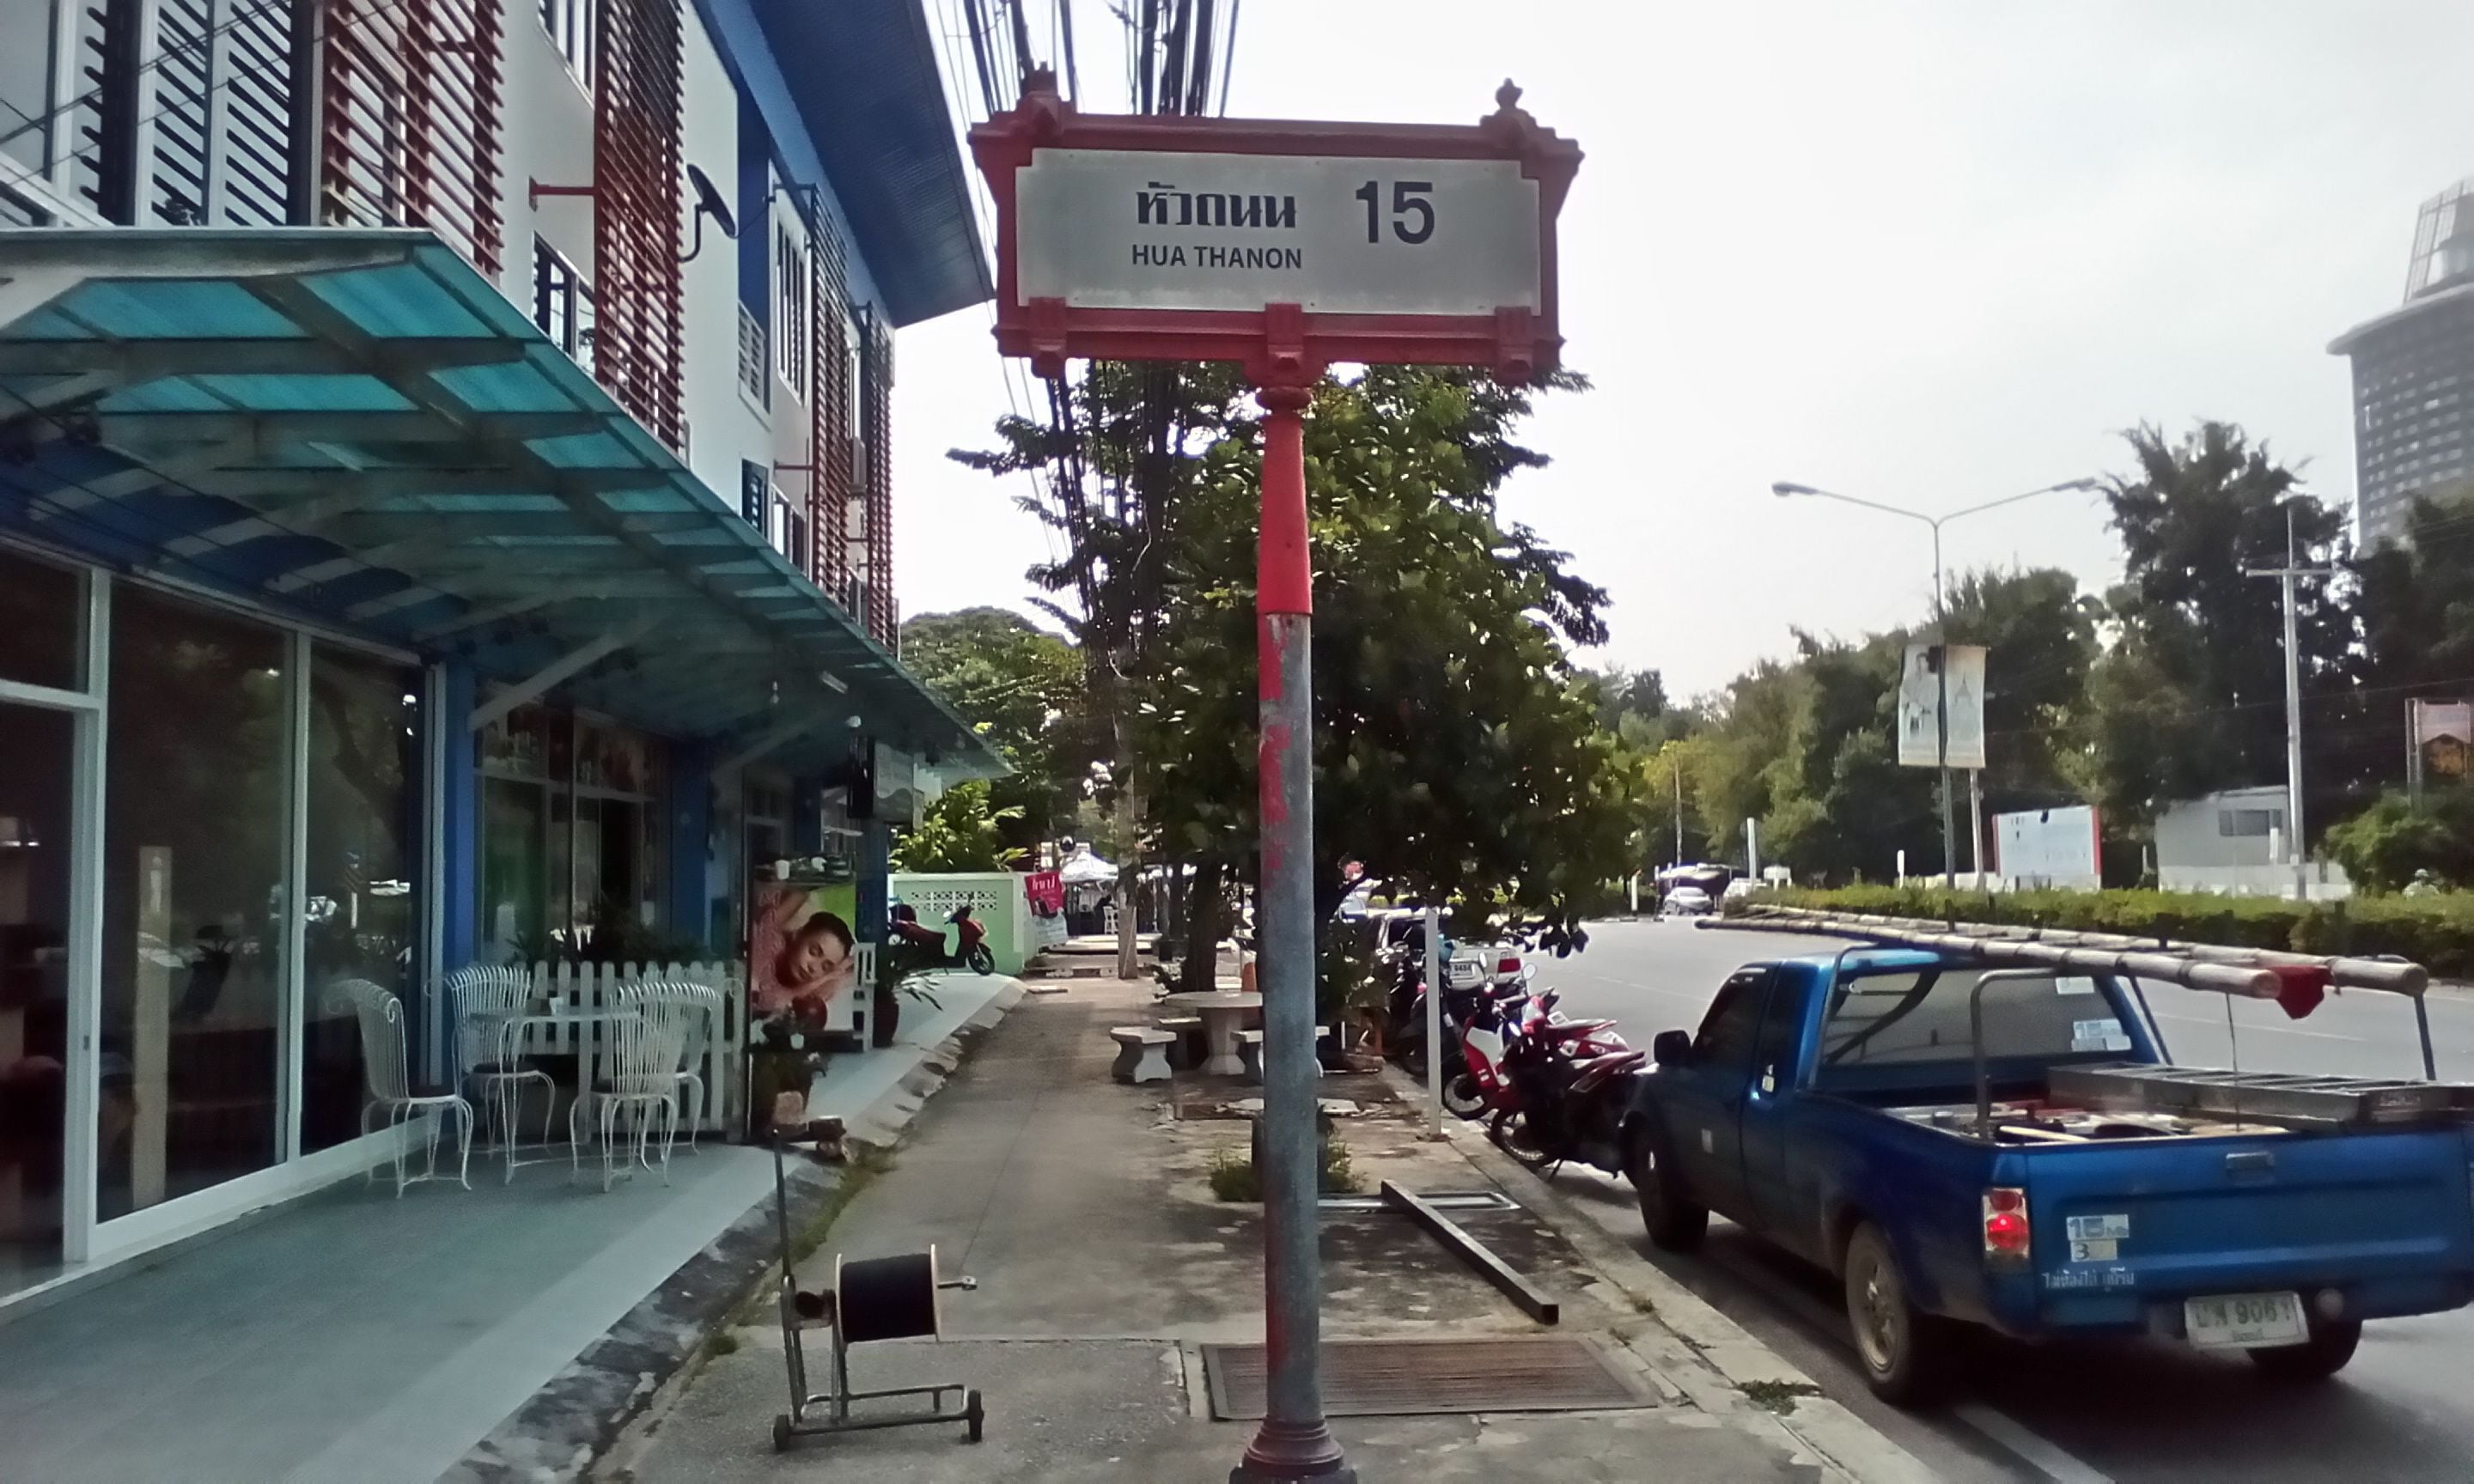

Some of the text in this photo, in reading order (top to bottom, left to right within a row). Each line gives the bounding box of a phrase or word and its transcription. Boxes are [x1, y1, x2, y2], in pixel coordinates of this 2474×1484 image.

[1136, 181, 1296, 228] หัวถนน
[1356, 180, 1435, 245] 15
[1132, 244, 1301, 270] HUA THANON
